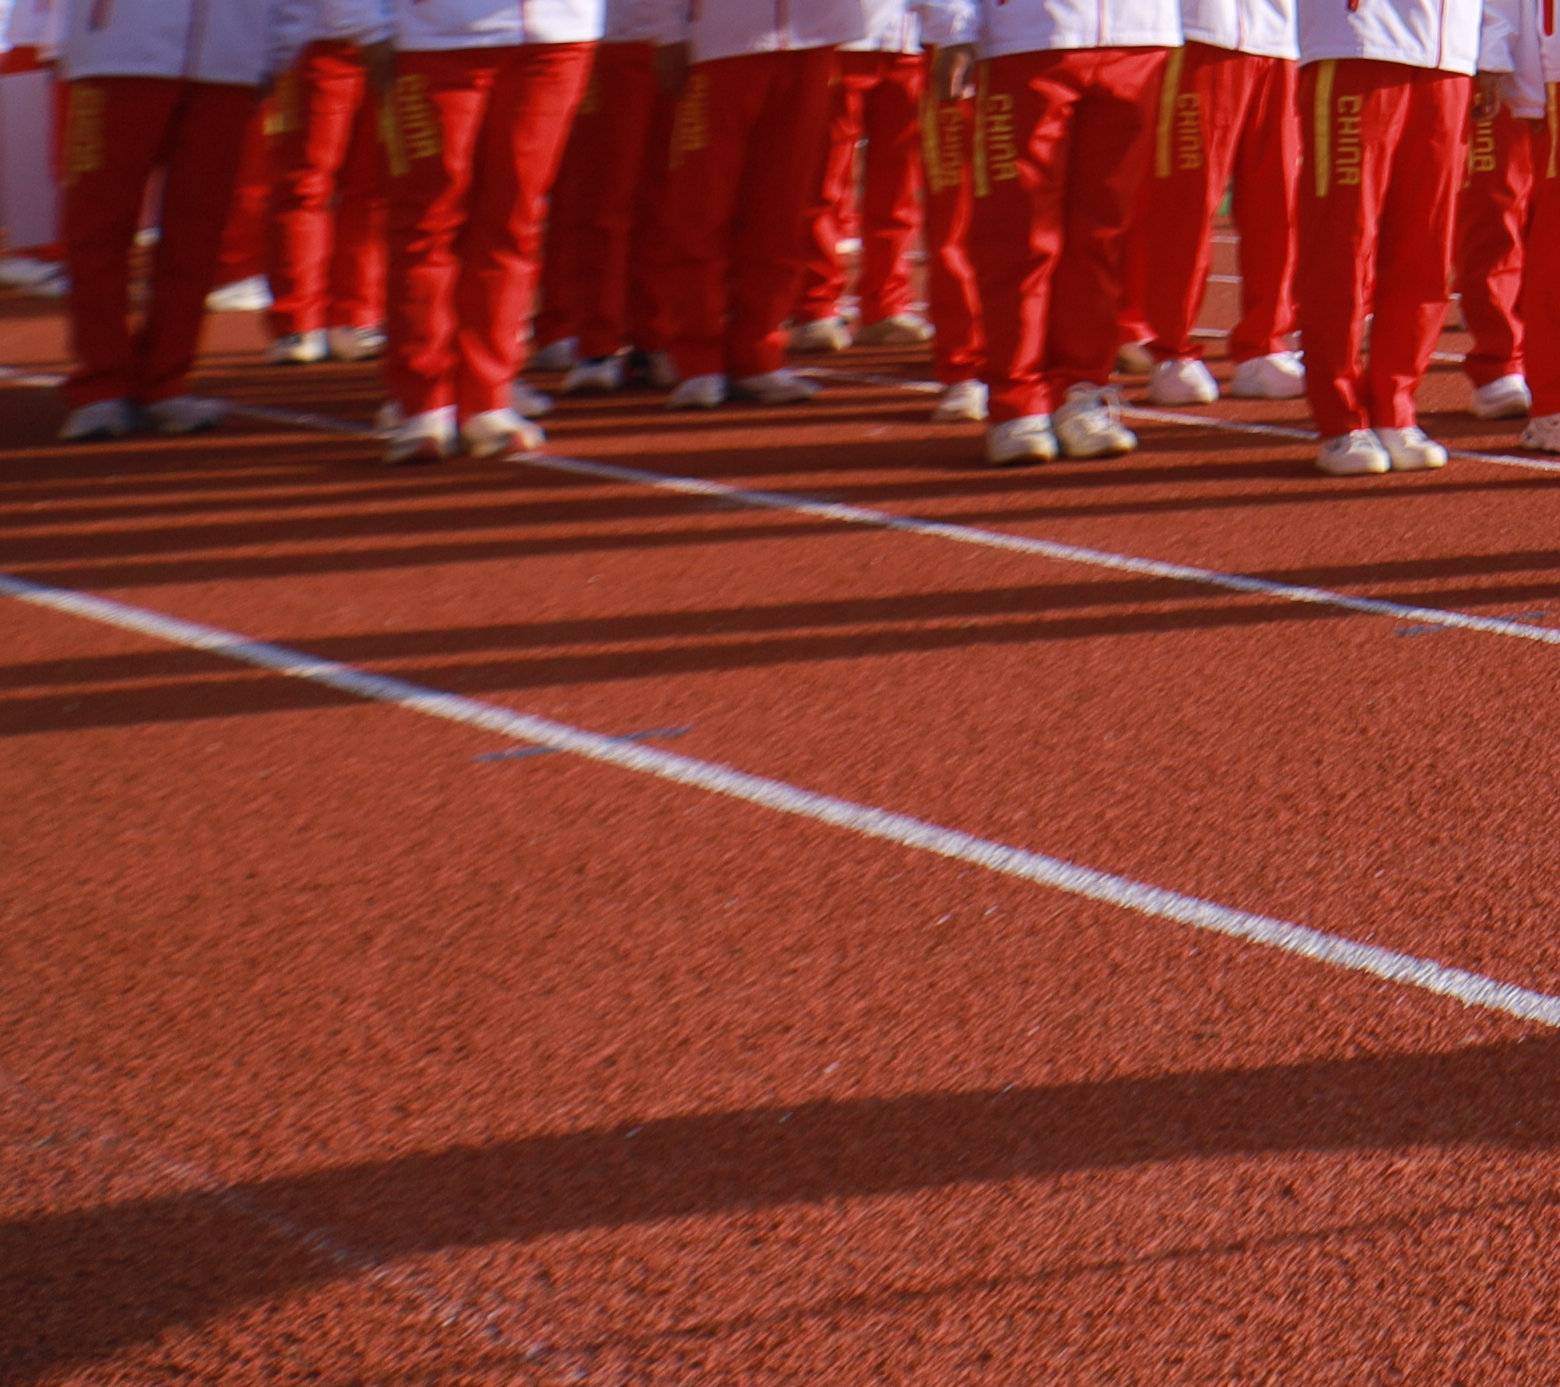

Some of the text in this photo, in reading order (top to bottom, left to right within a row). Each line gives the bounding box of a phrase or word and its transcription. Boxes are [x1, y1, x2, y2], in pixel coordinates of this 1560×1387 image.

[987, 94, 1020, 181] CHINA
[1176, 93, 1201, 169] CHINA
[1336, 95, 1362, 185] CHINA
